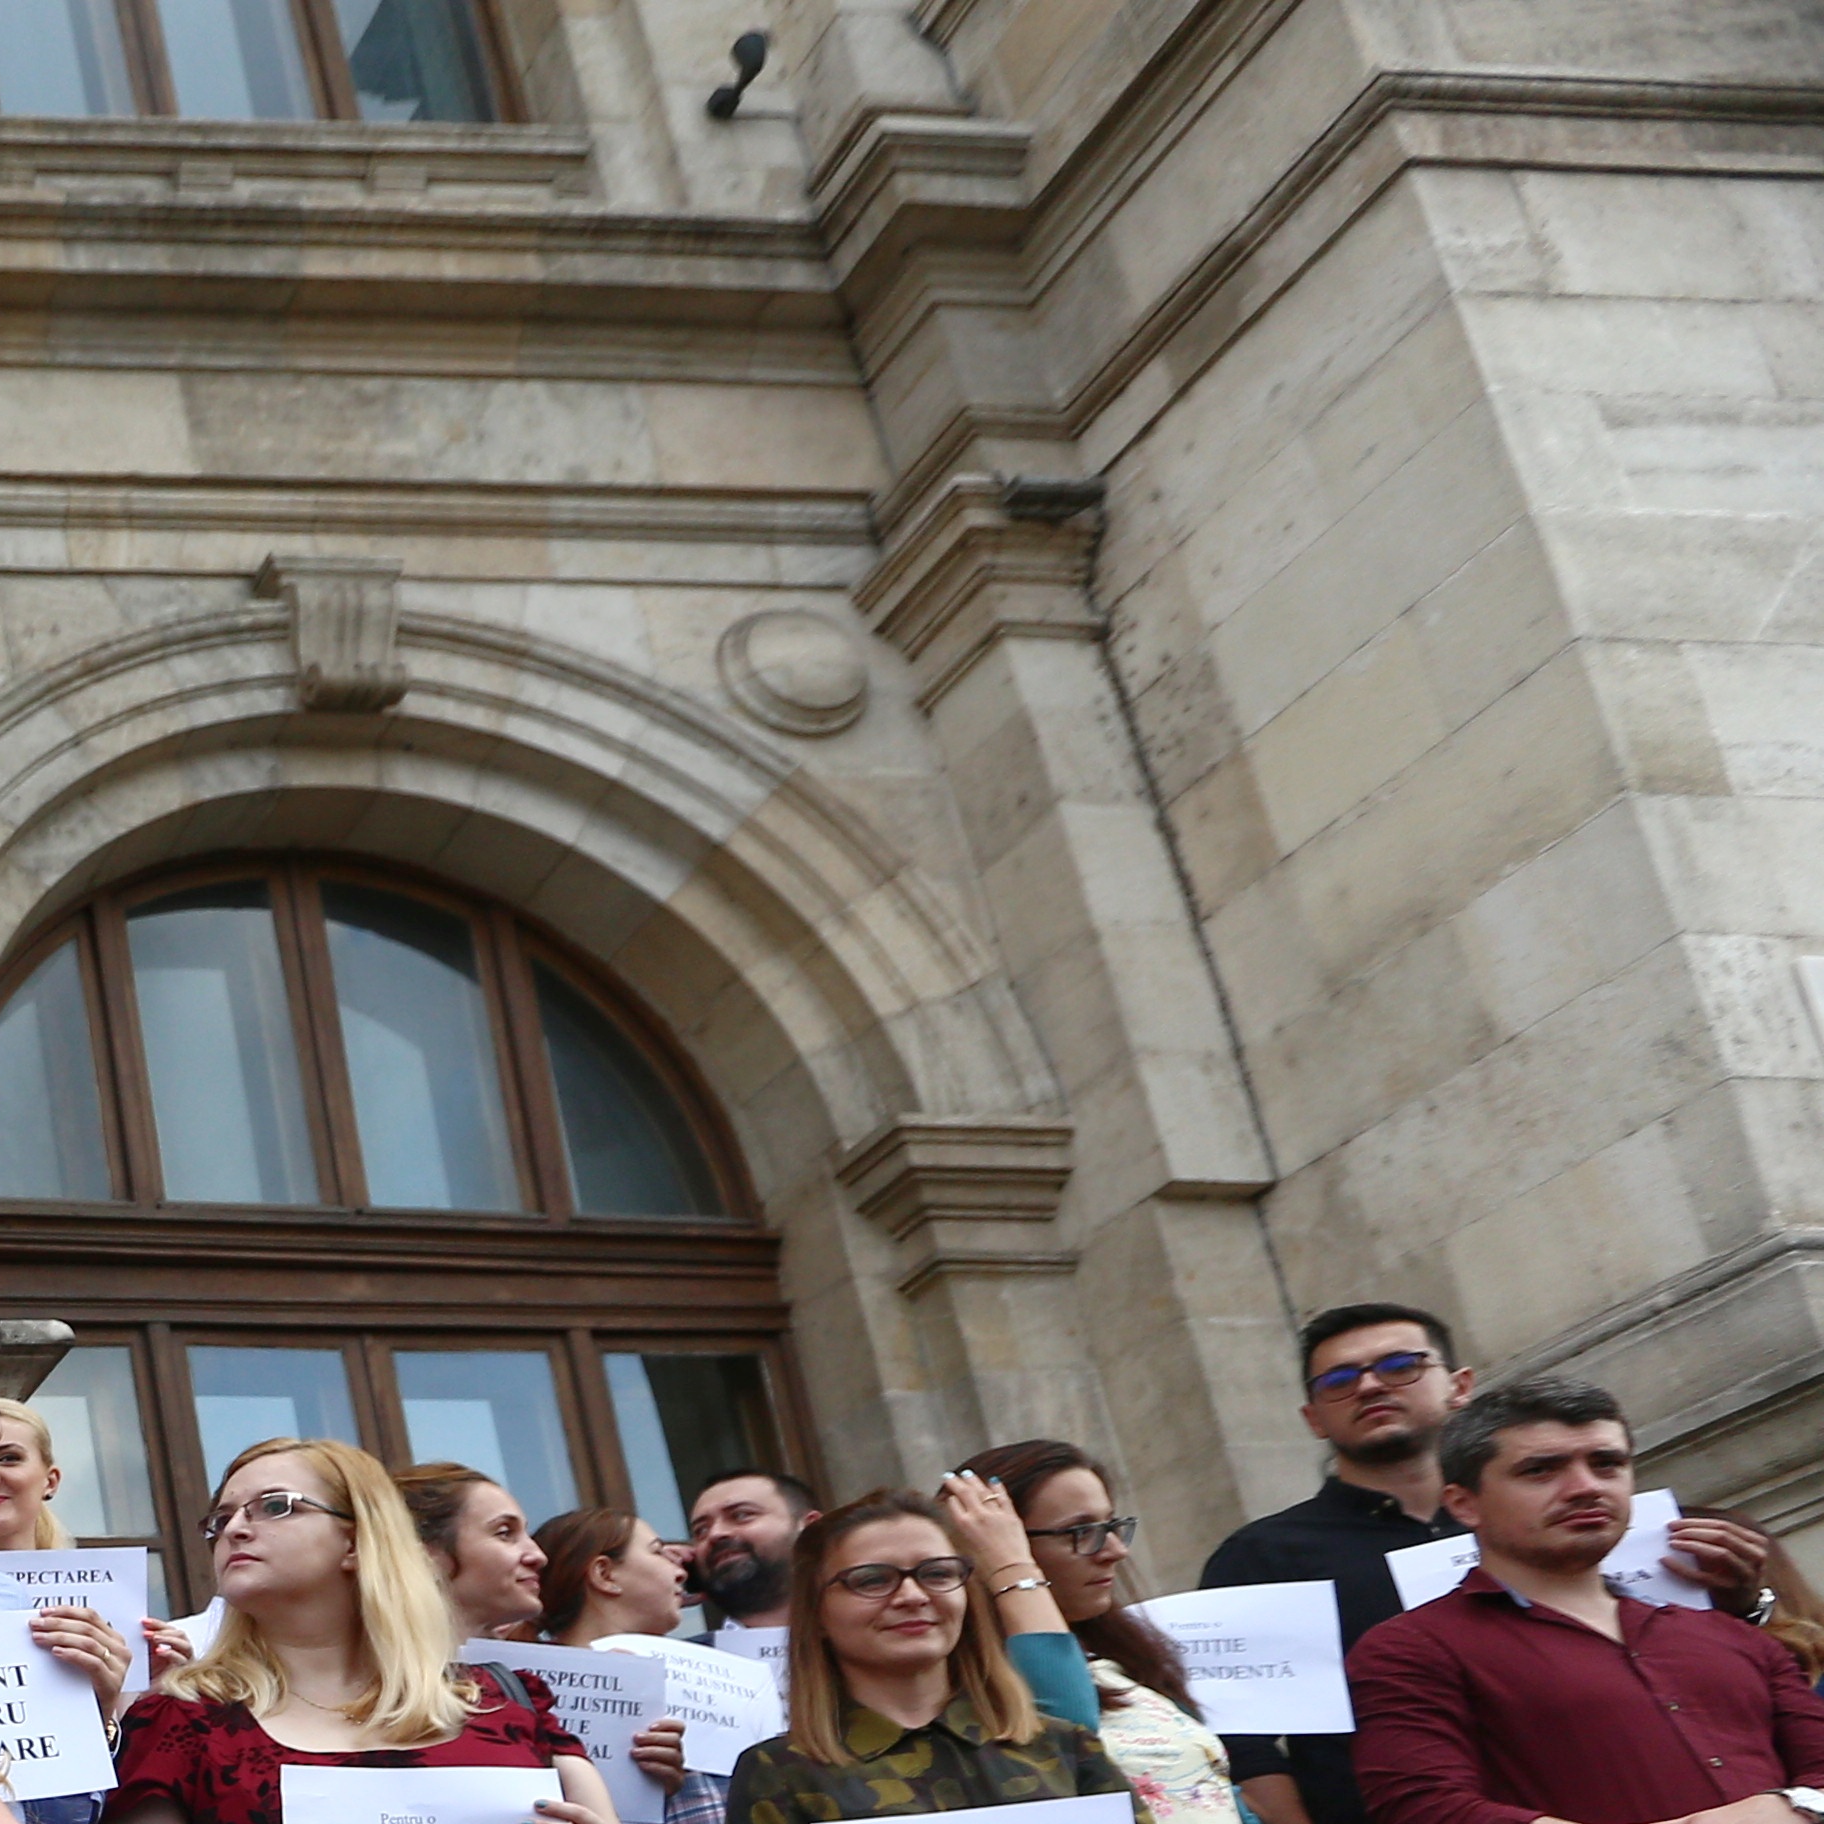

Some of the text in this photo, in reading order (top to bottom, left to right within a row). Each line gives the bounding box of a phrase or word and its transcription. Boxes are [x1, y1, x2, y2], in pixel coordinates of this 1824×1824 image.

[15, 1569, 114, 1585] PECTAREA
[1176, 1637, 1248, 1656] STIȚIE
[1188, 1660, 1295, 1681] ENDENTĂ
[570, 1697, 644, 1718] JUSTIȚIE
[580, 1720, 591, 1735] E
[426, 1815, 436, 1824] o
